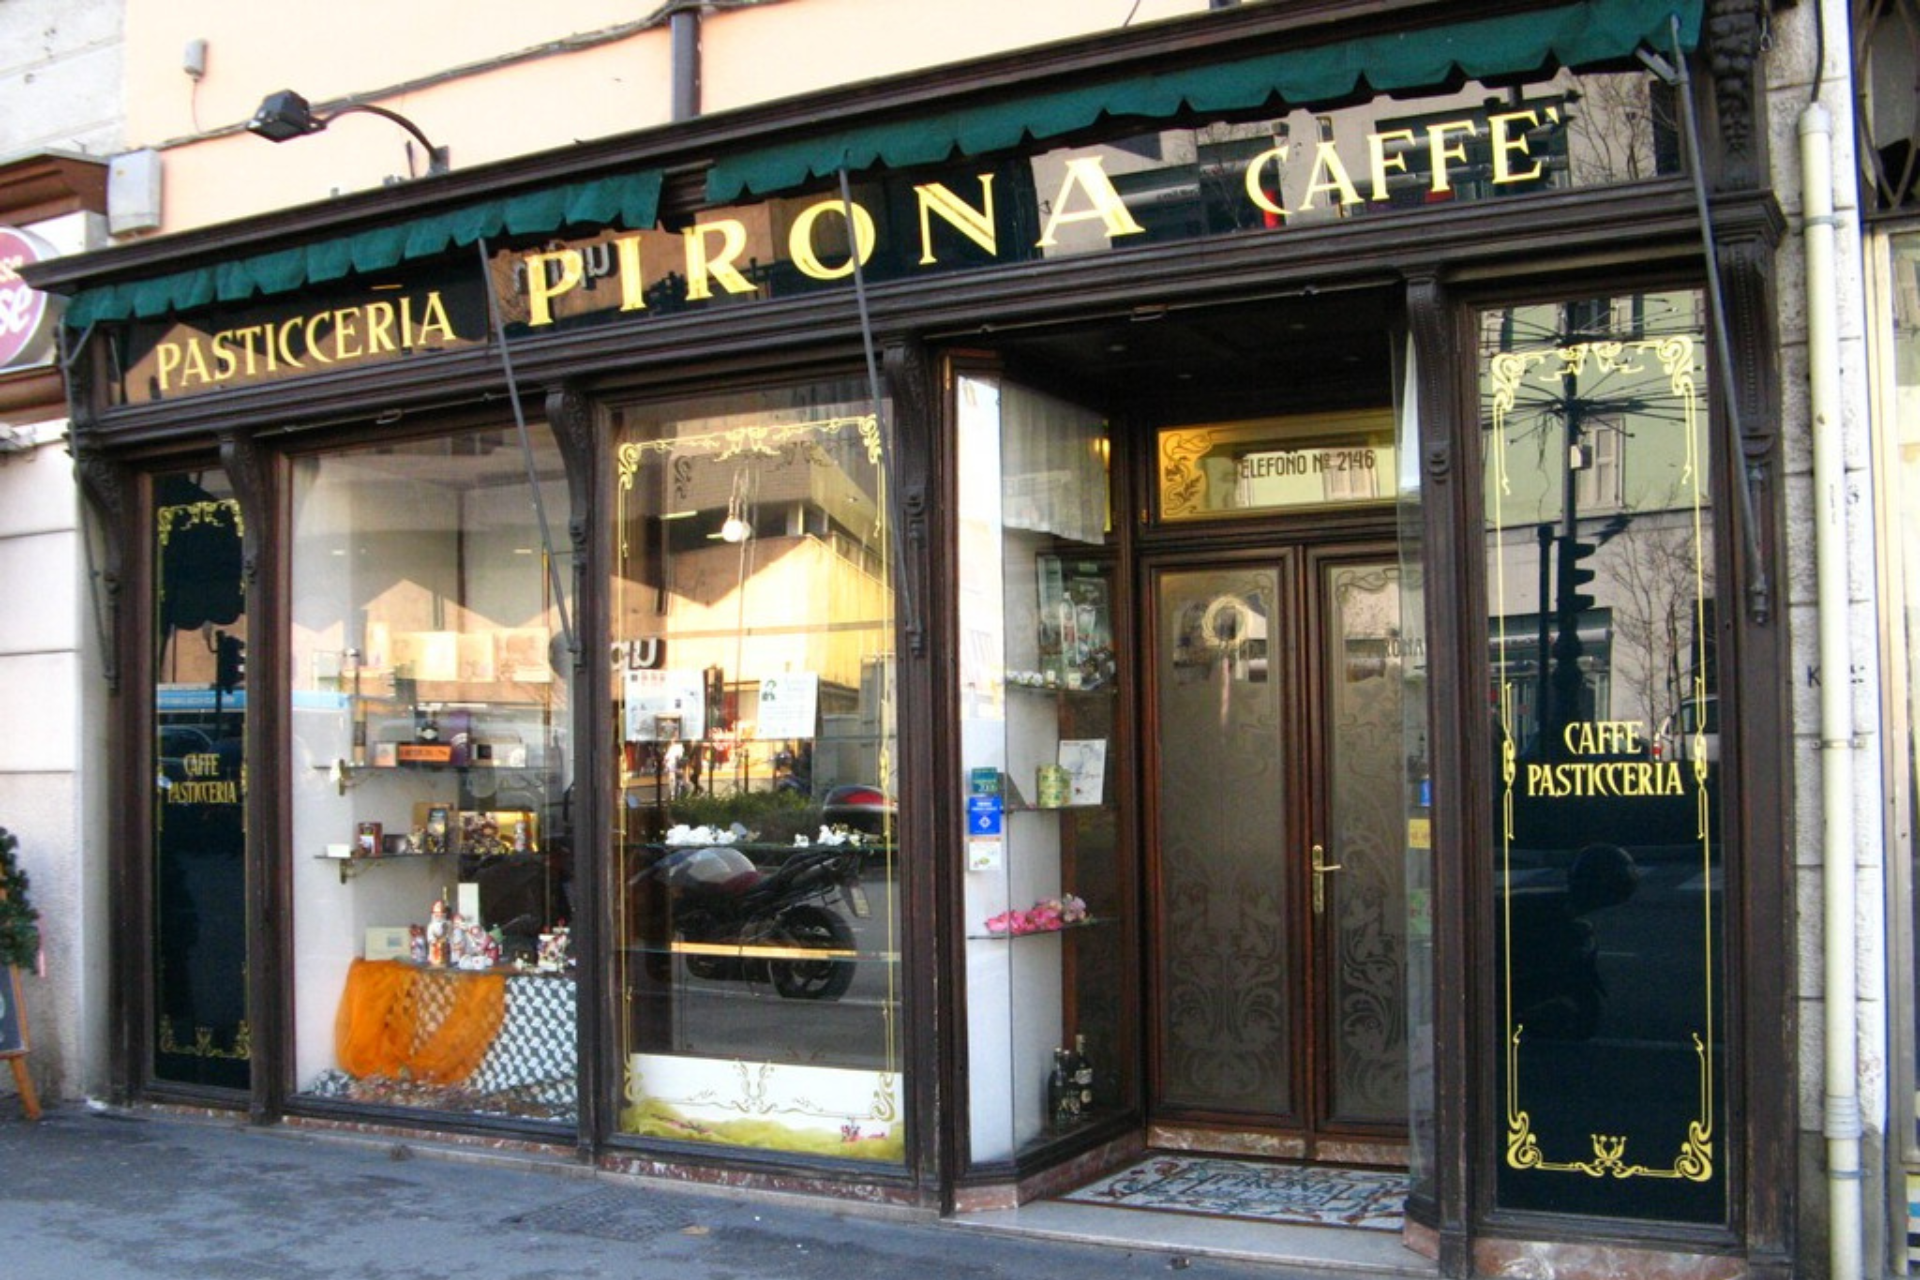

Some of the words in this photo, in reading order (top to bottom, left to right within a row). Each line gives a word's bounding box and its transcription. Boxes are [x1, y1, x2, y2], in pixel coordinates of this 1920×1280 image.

[157, 290, 456, 390] PASTICCERIA
[524, 155, 1146, 327] PIRONA
[1236, 454, 1307, 479] ELEFONO
[1336, 449, 1376, 472] 2146
[1563, 721, 1644, 755] CAFFE
[1526, 762, 1685, 798] PASTICCERIA
